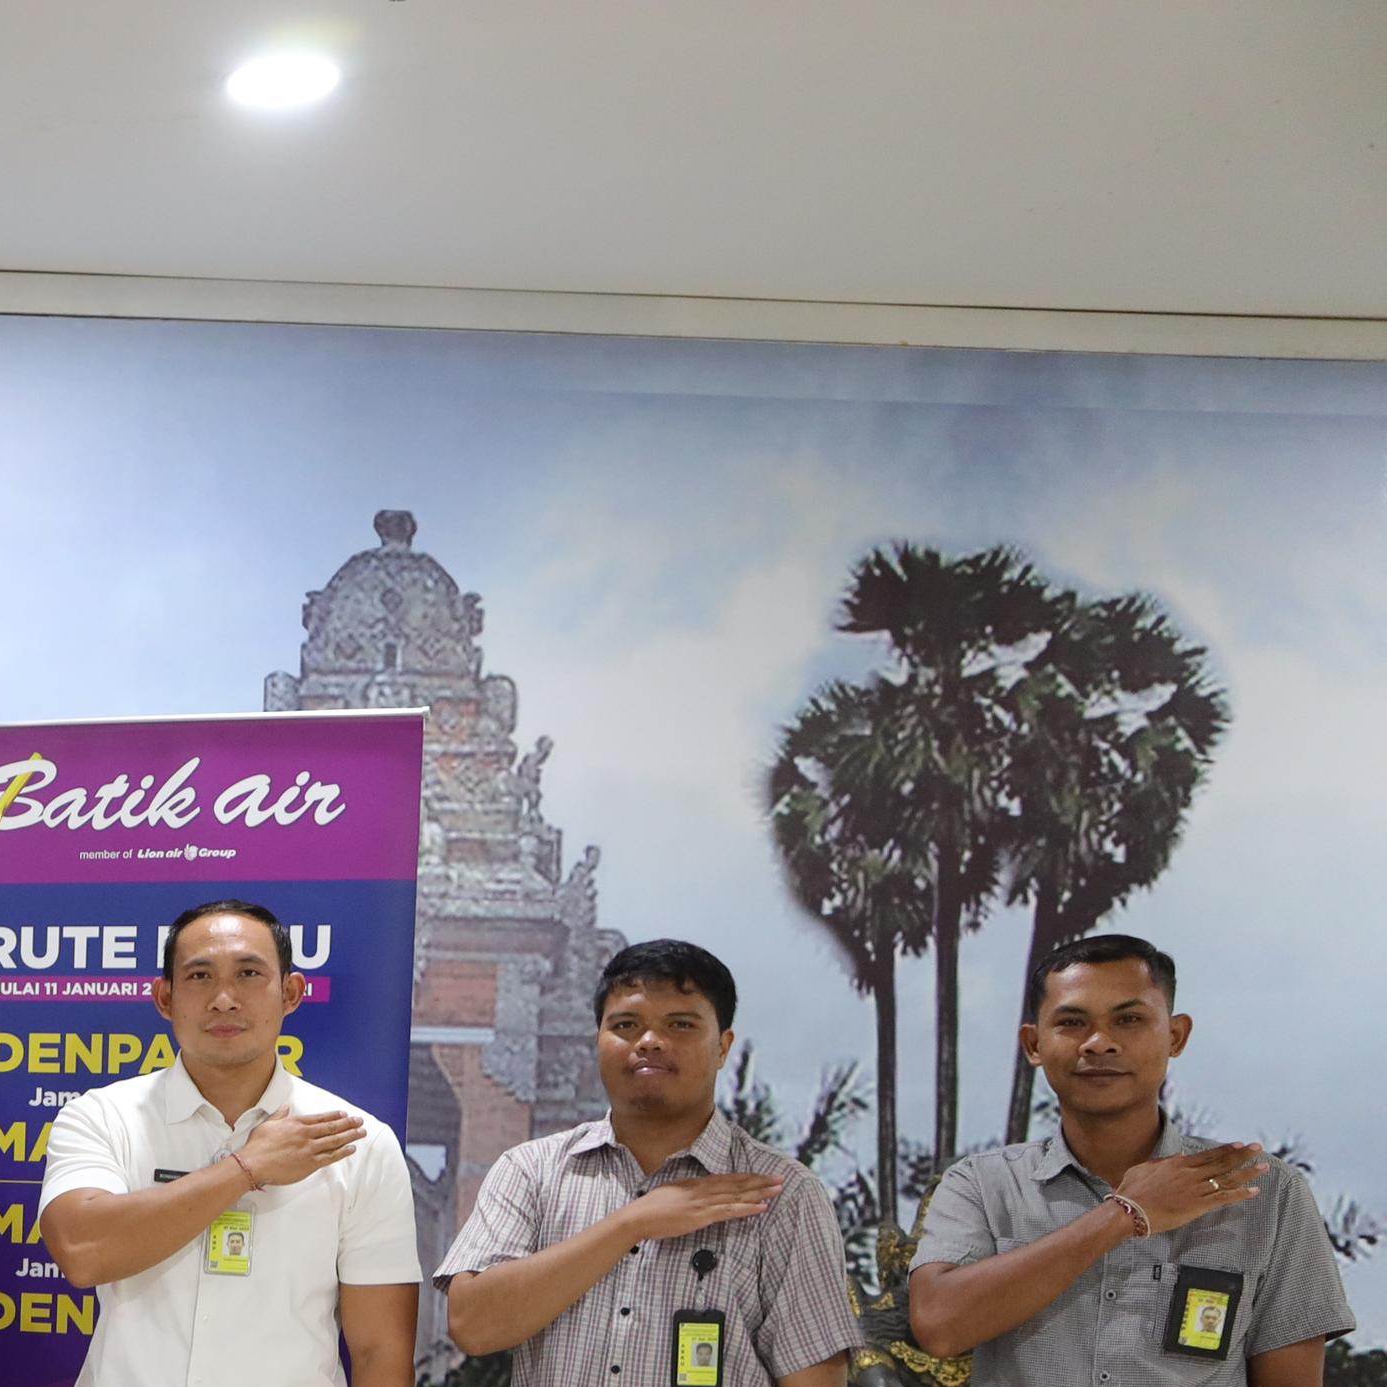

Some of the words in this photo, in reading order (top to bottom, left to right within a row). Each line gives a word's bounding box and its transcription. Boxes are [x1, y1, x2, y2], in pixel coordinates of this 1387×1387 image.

[212, 769, 347, 827] air
[79, 849, 121, 861] member
[123, 848, 133, 860] of
[137, 848, 164, 860] Lion
[164, 847, 184, 859] air
[198, 847, 237, 860] Group
[43, 981, 58, 995] 11
[61, 980, 138, 997] JANUARI
